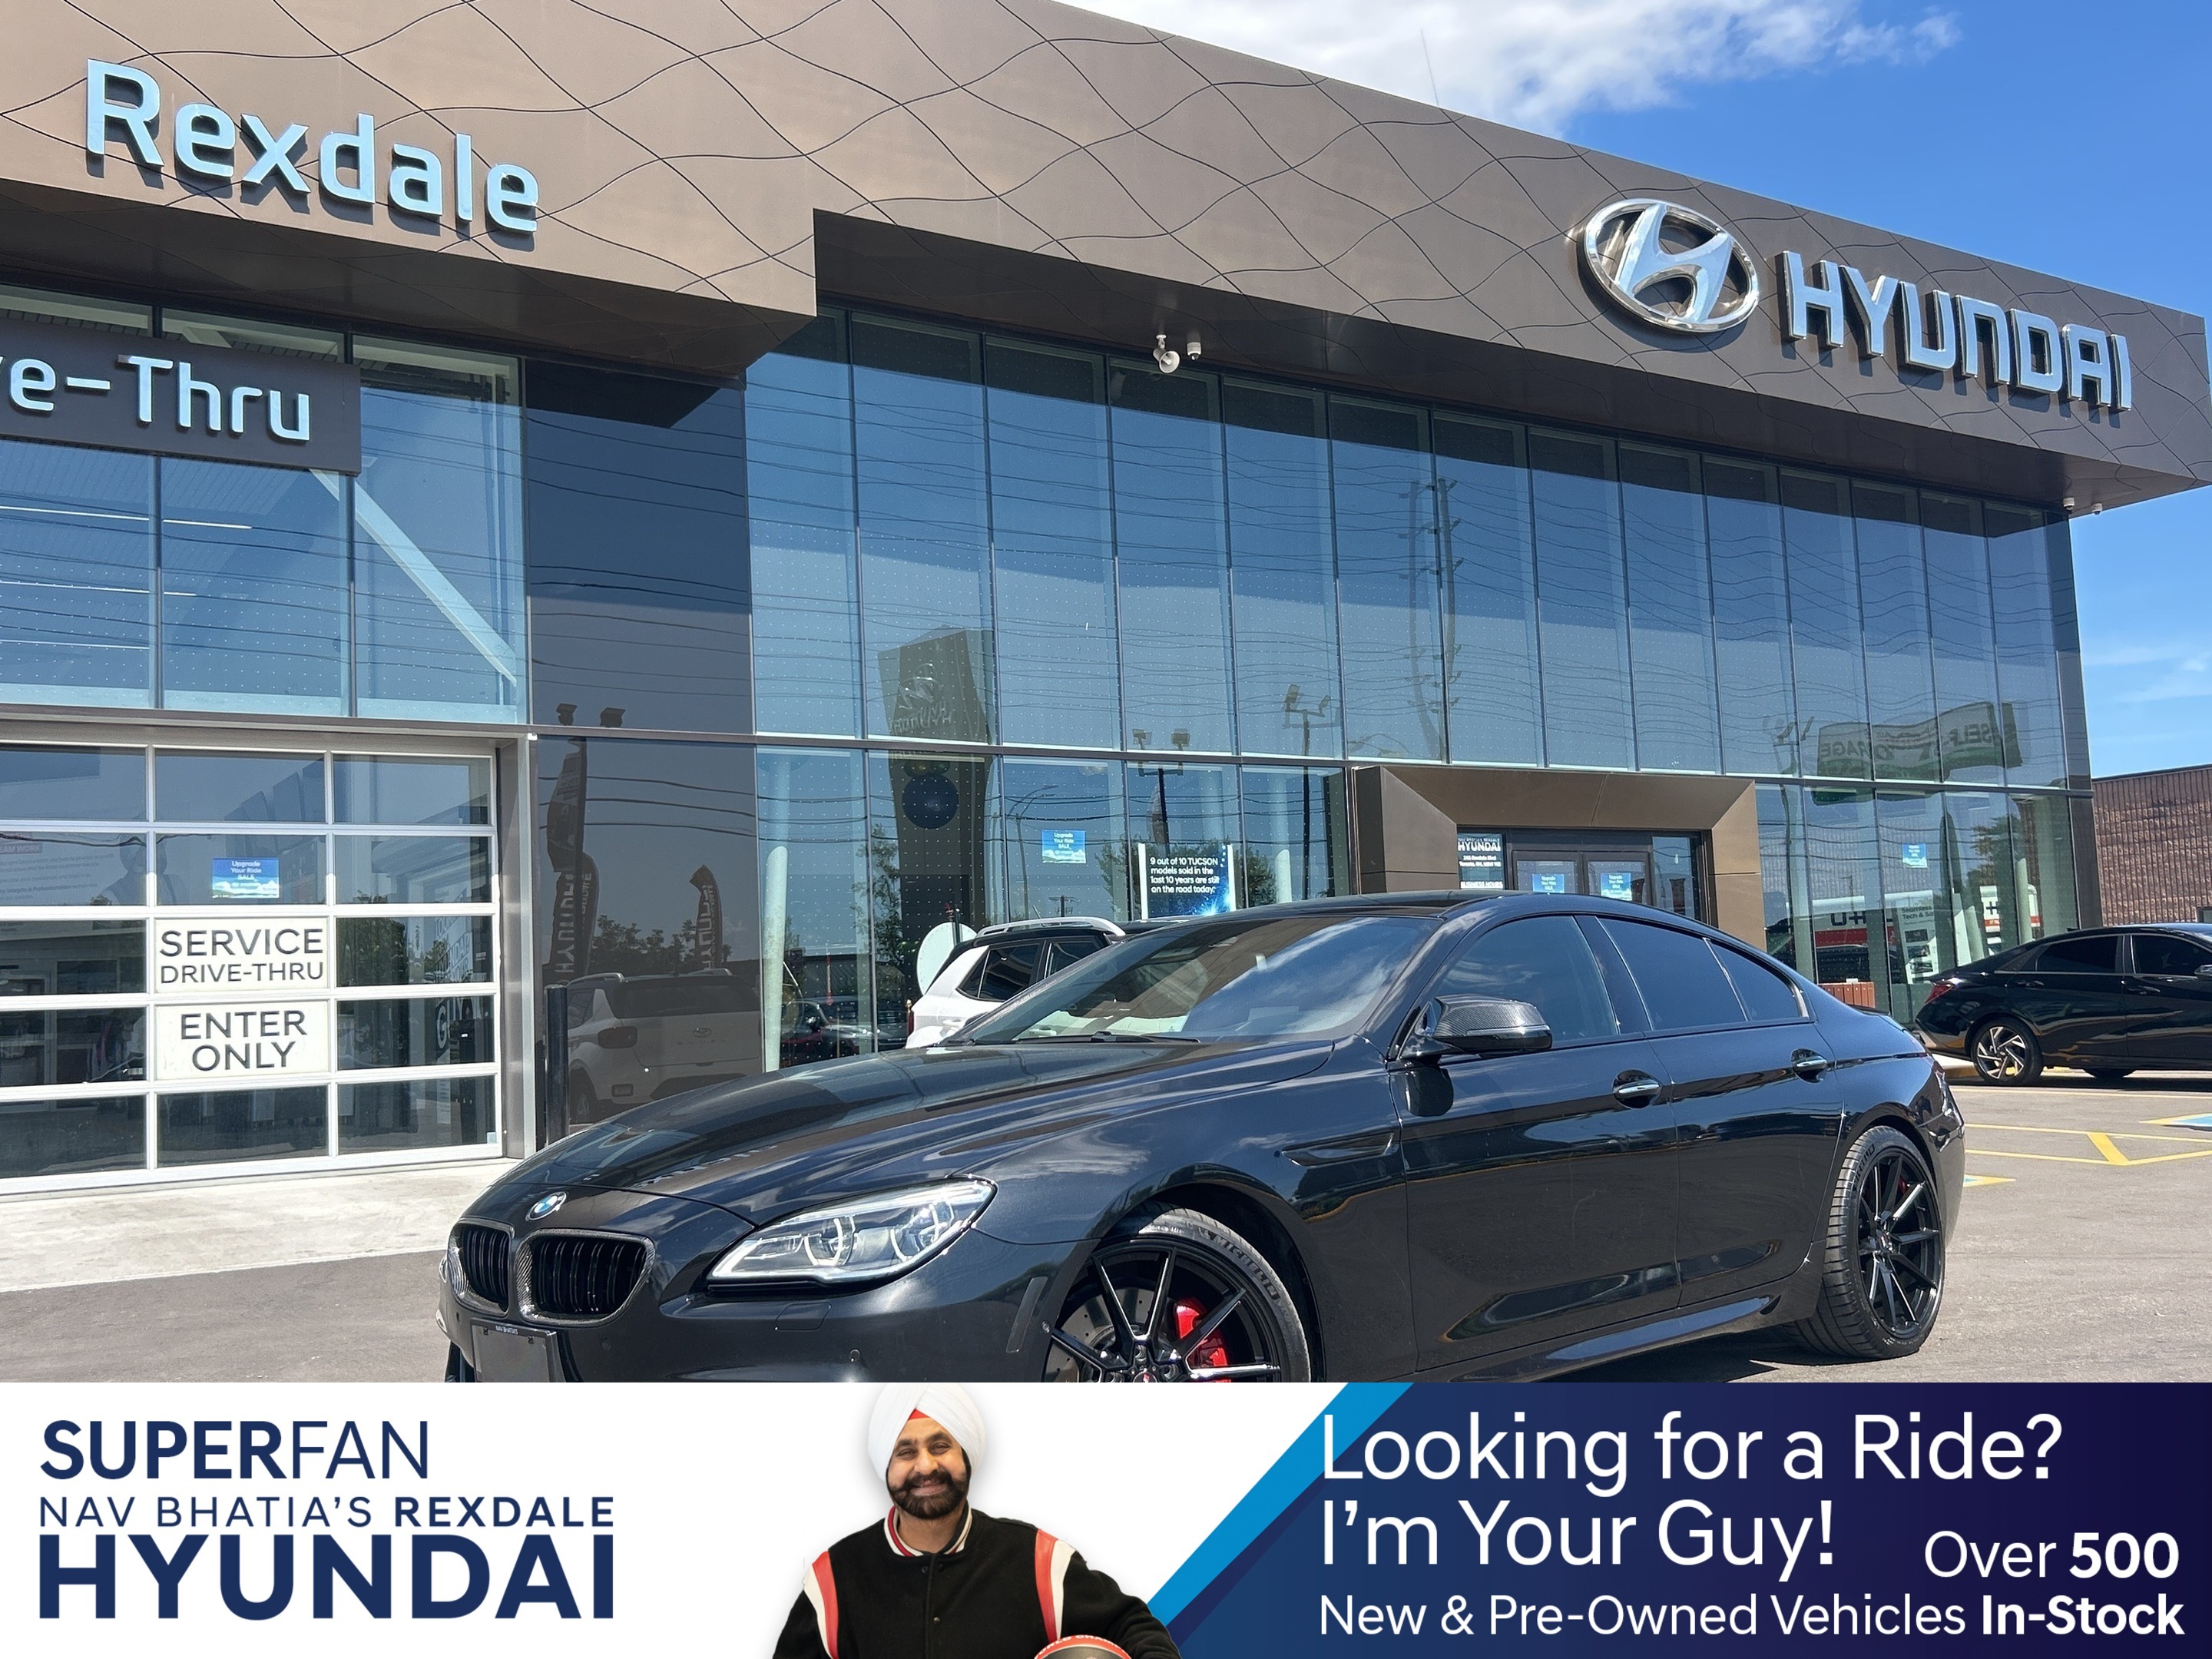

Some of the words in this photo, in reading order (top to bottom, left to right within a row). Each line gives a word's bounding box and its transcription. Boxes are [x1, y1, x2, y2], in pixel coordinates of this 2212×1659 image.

[86, 58, 540, 233] Rexdale
[1779, 250, 2133, 411] HYUNDAI
[0, 353, 311, 442] e-Thru
[1458, 841, 1502, 852] HYUNDAI
[1151, 866, 1177, 875] models
[1178, 866, 1194, 875] sold
[1202, 866, 1214, 875] the
[1187, 857, 1218, 866] TUCSON
[1162, 885, 1174, 893] the
[1175, 876, 1194, 885] years
[1207, 876, 1220, 884] still
[160, 929, 323, 957] SERVICE
[161, 962, 323, 983] DRIVE-THRU
[181, 1010, 307, 1040] ENTER
[192, 1041, 296, 1071] ONLY
[1210, 1234, 1281, 1300] MICHELIN
